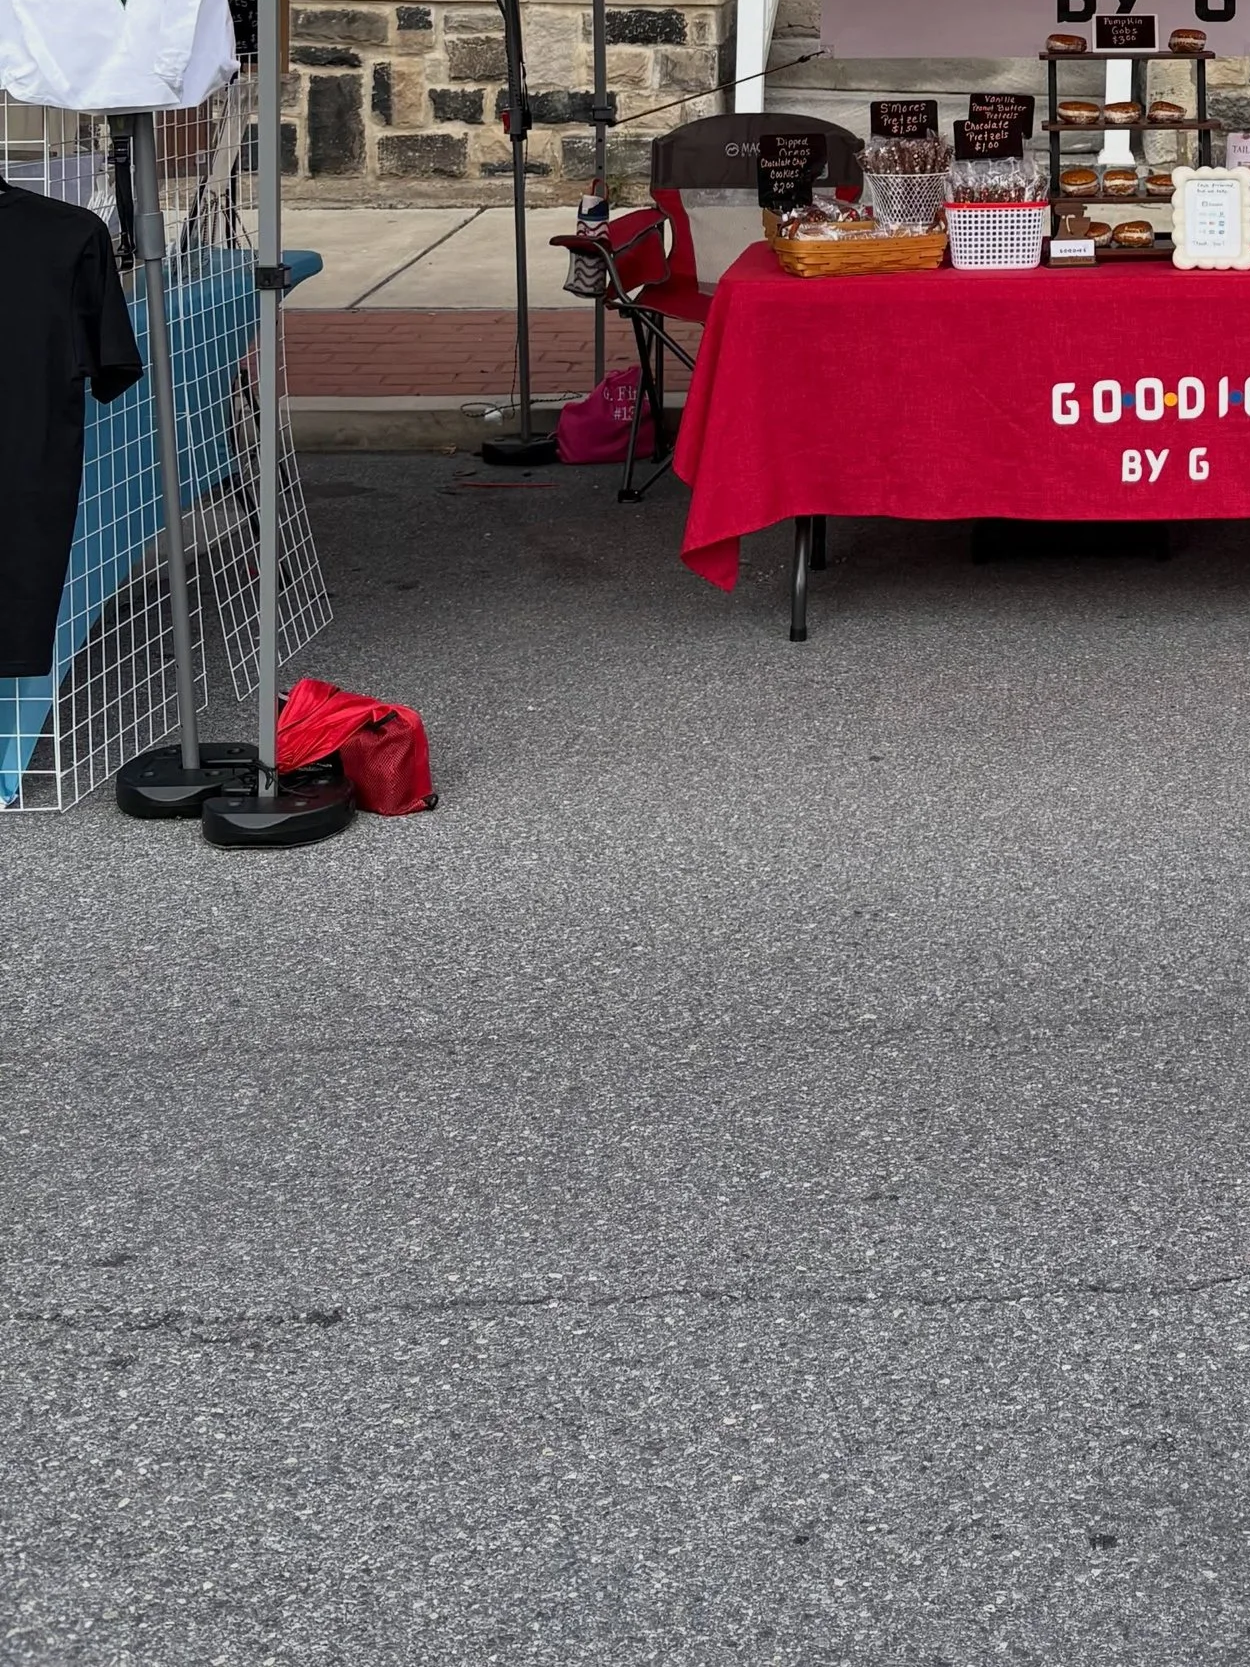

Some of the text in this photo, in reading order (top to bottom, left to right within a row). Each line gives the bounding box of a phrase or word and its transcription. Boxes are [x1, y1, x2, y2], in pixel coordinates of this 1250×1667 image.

[1111, 26, 1138, 35] Gobs
[972, 103, 1027, 112] Peanut Butter
[880, 113, 928, 126] Pretzels
[964, 120, 1009, 131] Chocolate
[966, 130, 1009, 142] Pretzels
[776, 137, 809, 148] Dipped
[760, 158, 791, 168] Chocolate
[770, 169, 800, 180] Cookies
[1121, 447, 1210, 483] BY G
